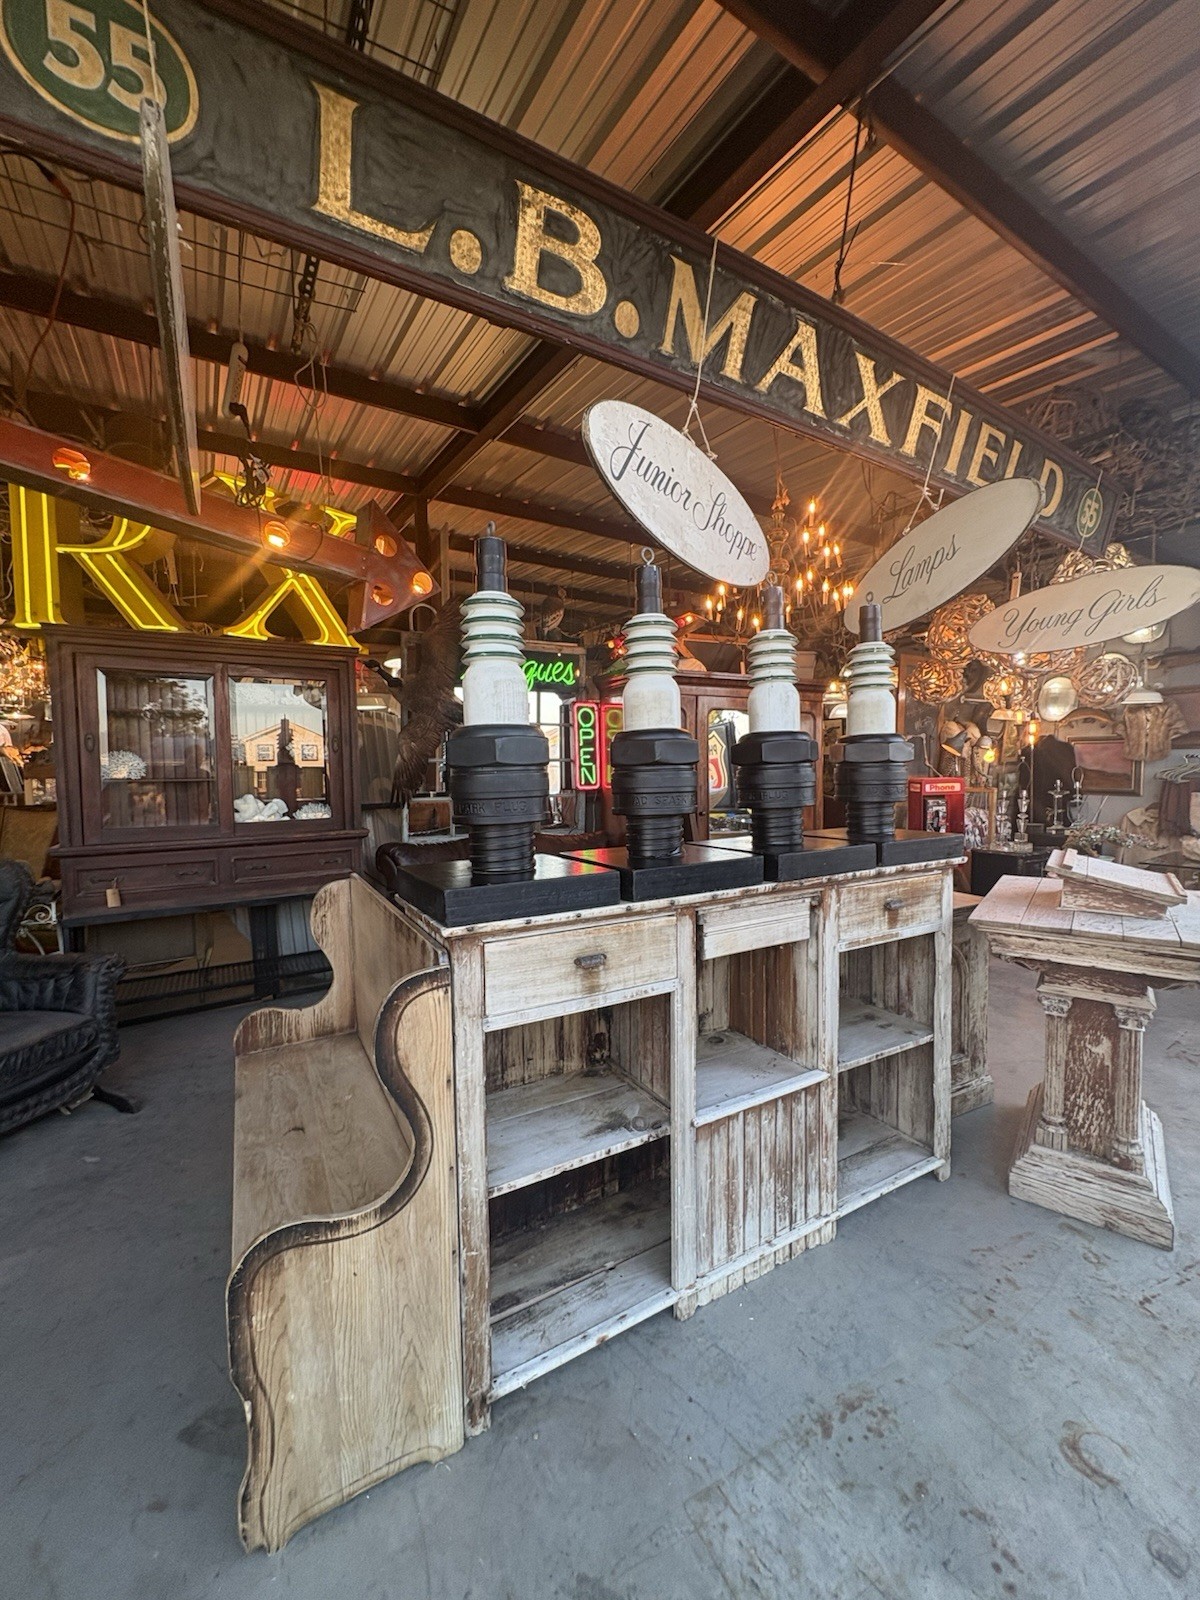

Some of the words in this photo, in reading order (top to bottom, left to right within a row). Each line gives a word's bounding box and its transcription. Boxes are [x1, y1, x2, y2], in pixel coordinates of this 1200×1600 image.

[42, 0, 167, 113] 55
[610, 420, 693, 511] Junior
[692, 482, 762, 562] Shoppe
[882, 534, 961, 604] Lamps
[998, 607, 1083, 647] Young
[1084, 574, 1167, 638] Girls
[577, 707, 597, 785] OPEN
[493, 800, 528, 814] PLUG
